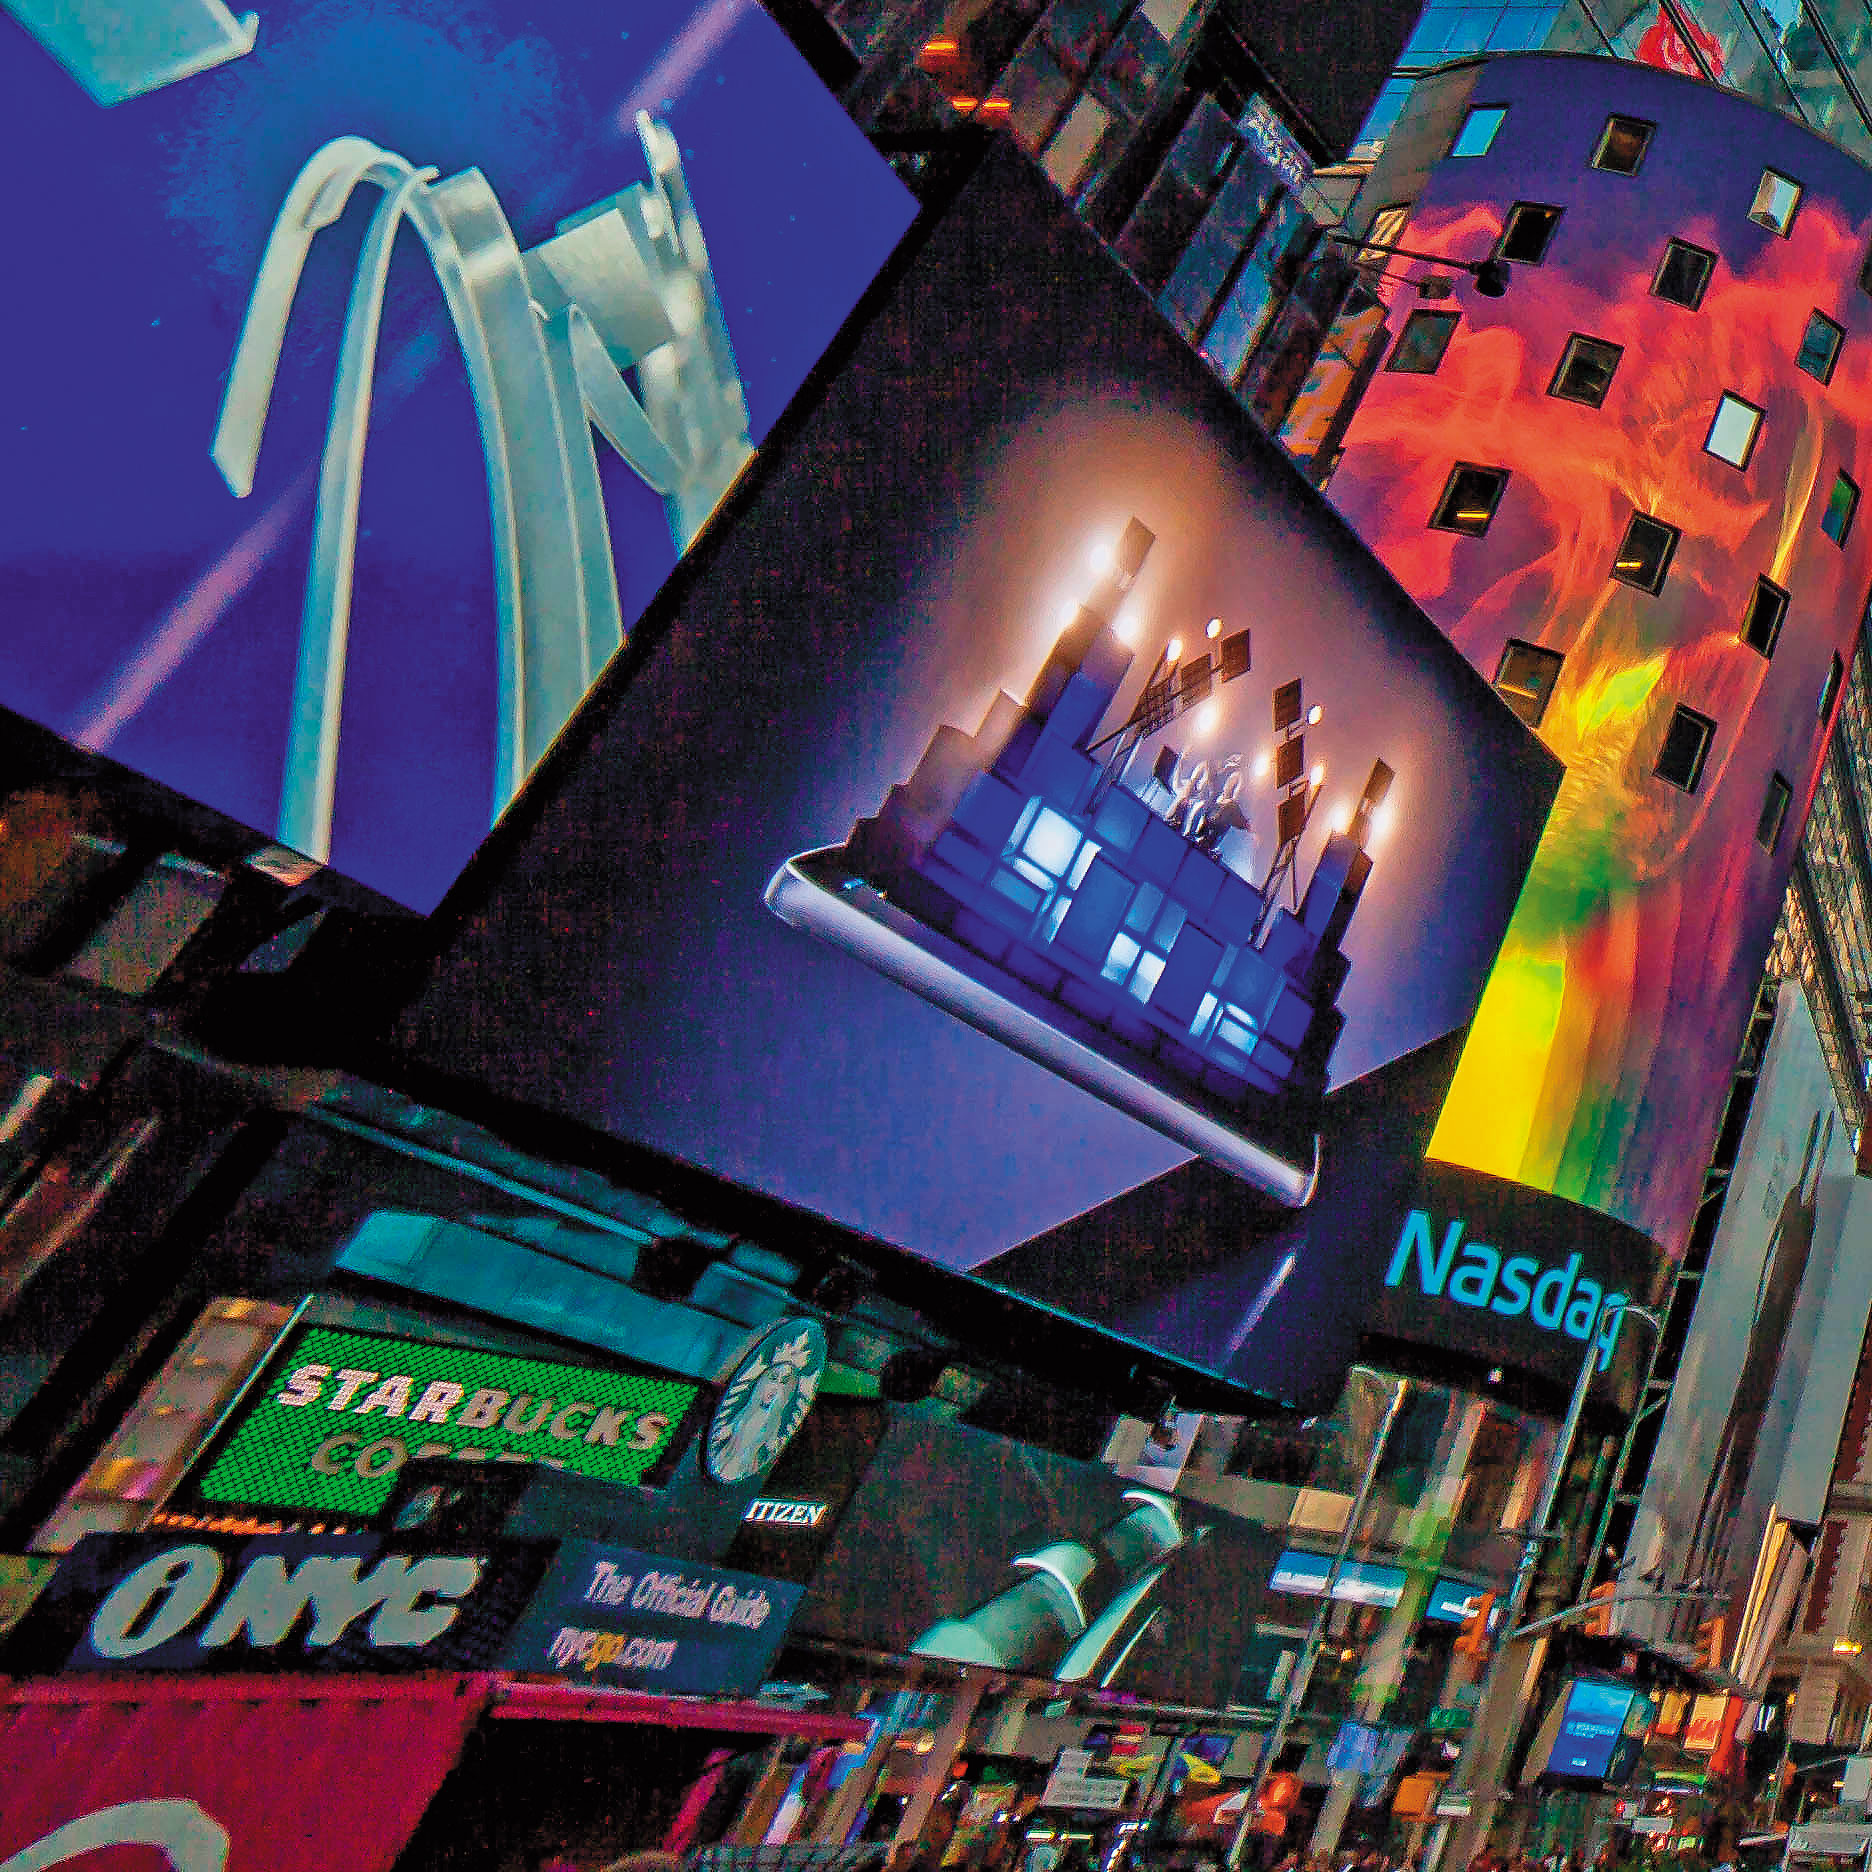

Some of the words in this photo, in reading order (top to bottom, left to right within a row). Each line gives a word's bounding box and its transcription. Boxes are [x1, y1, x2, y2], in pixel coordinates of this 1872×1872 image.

[1385, 1208, 1628, 1372] Nasdaq
[275, 1363, 673, 1454] STARBUCKS
[200, 1554, 487, 1649] NYC
[585, 1560, 626, 1600] The
[630, 1568, 707, 1618] Official
[708, 1587, 771, 1629] Guide
[548, 1625, 678, 1673] nycgo.com
